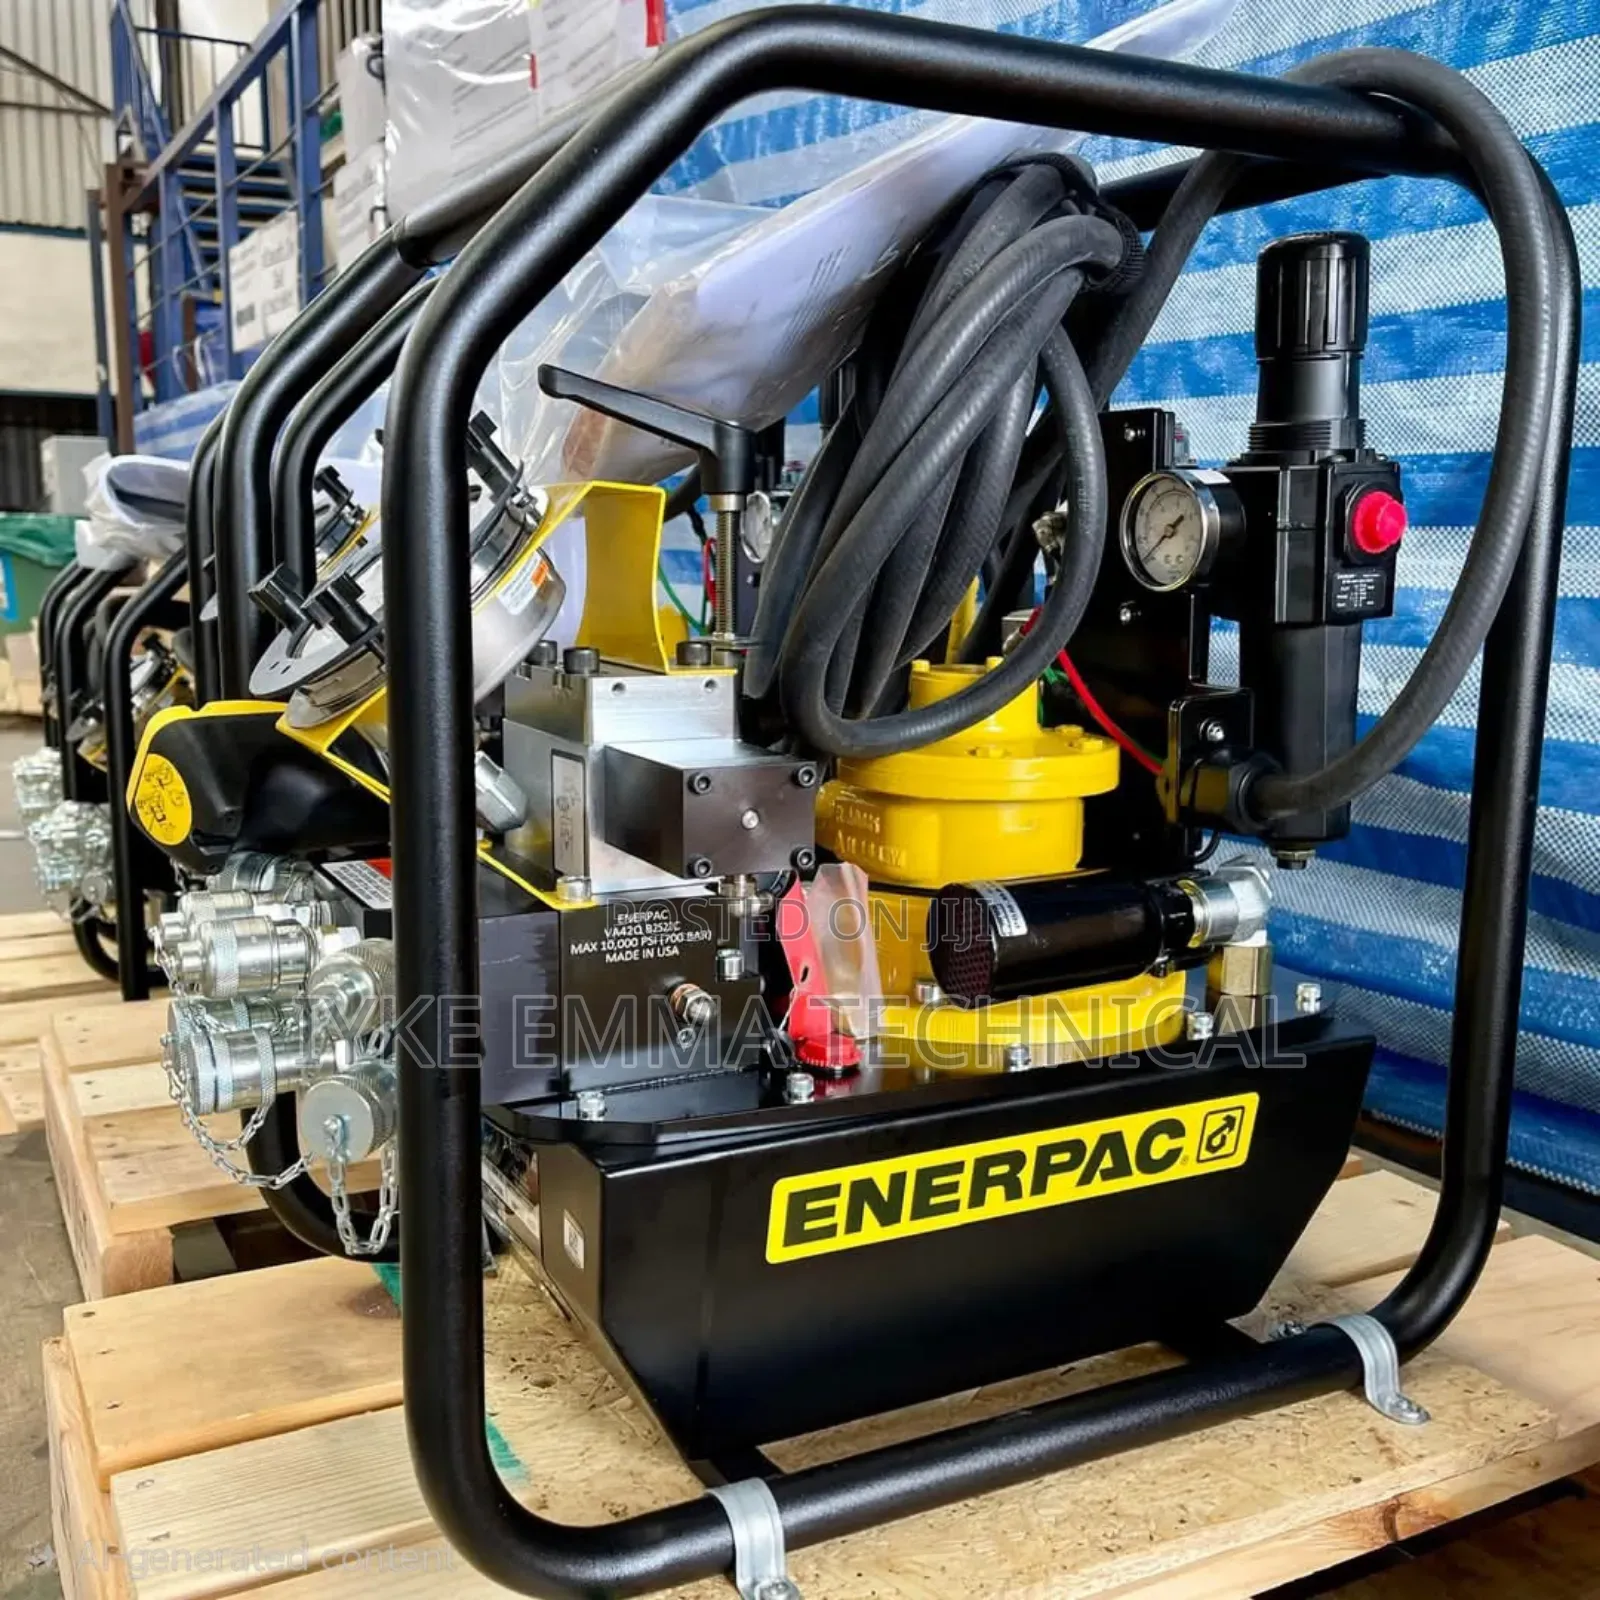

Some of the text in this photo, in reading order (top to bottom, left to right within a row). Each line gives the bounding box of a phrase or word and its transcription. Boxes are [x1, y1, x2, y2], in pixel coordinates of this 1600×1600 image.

[617, 909, 670, 924] ENERPAC
[570, 941, 598, 956] MAX
[601, 937, 639, 951] 10,000
[640, 934, 658, 947] PSI
[605, 945, 680, 964] MADE IN USA
[782, 1118, 1186, 1248] ENERPAC
